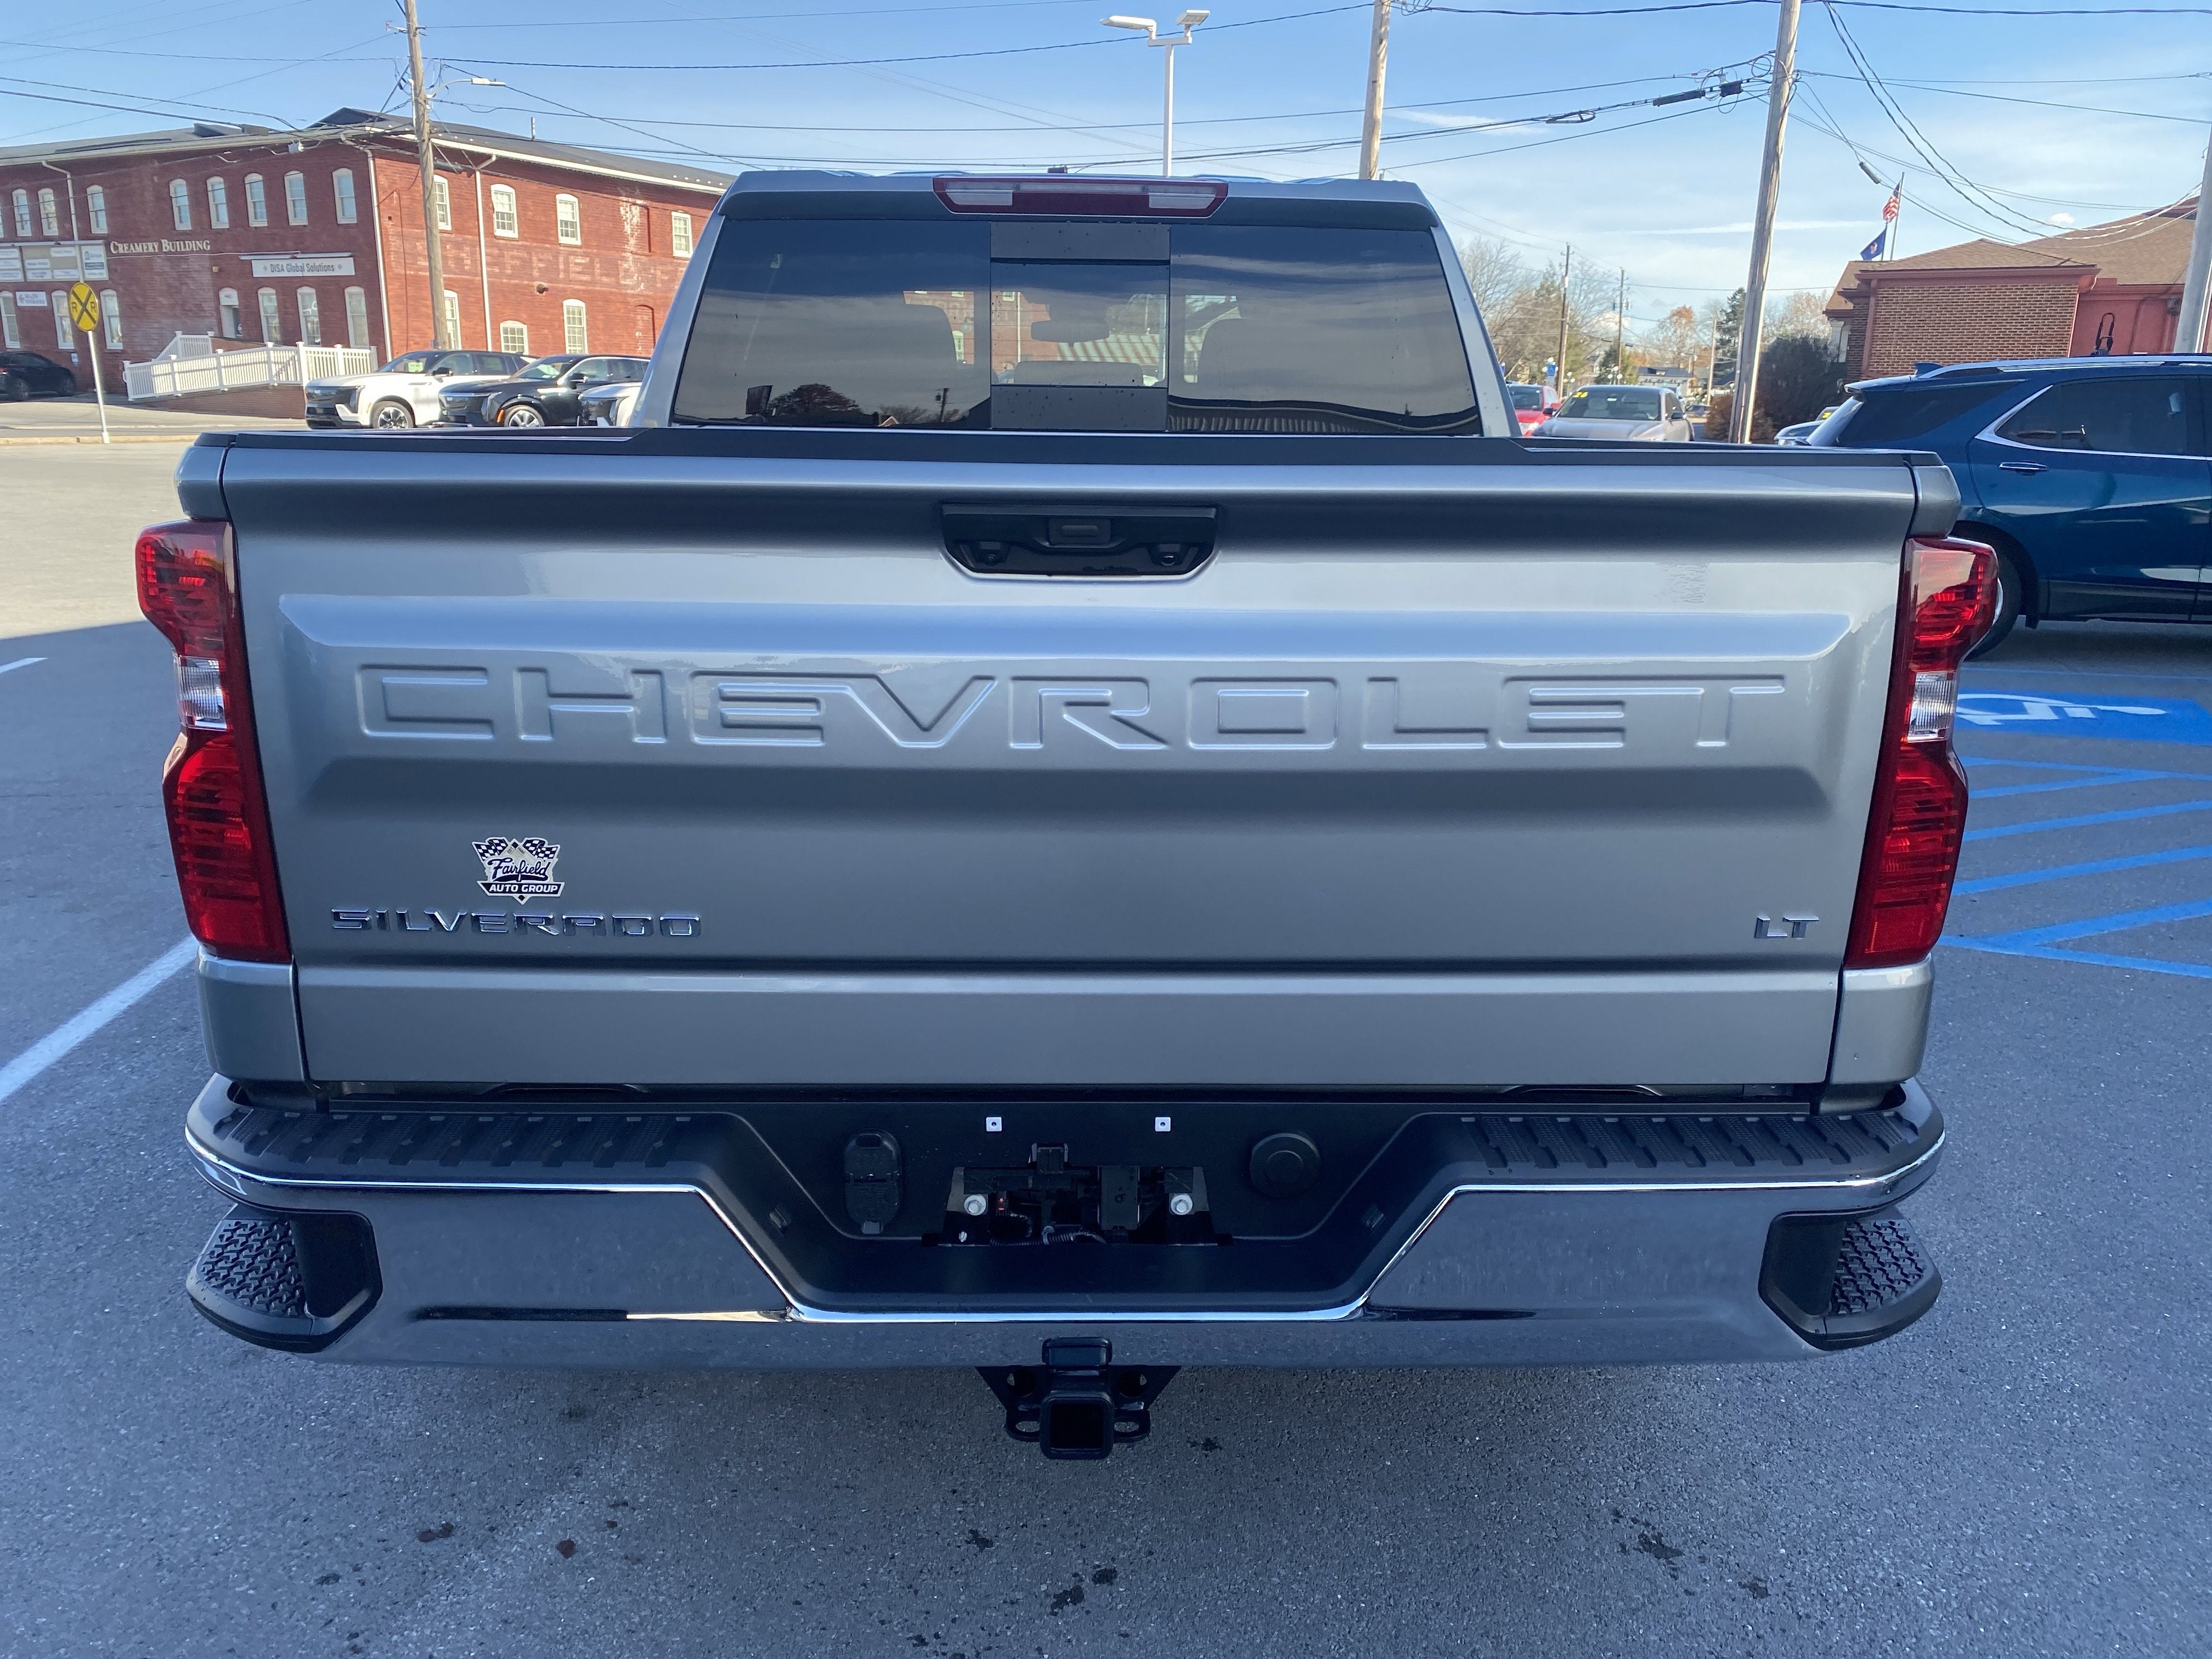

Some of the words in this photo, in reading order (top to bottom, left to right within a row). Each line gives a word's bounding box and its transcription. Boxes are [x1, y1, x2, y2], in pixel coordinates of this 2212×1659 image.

[110, 241, 159, 254] CREAMERY
[160, 239, 211, 252] BUILDING
[270, 264, 284, 273] DISA
[286, 263, 304, 273] Global
[306, 262, 335, 273] Solutions
[354, 664, 1787, 752] CHEVROLET
[487, 857, 551, 883] Fairfield
[489, 884, 518, 893] AUTO
[521, 884, 558, 893] GROUP
[330, 909, 702, 937] SILVERADO
[1754, 915, 1819, 939] LT
